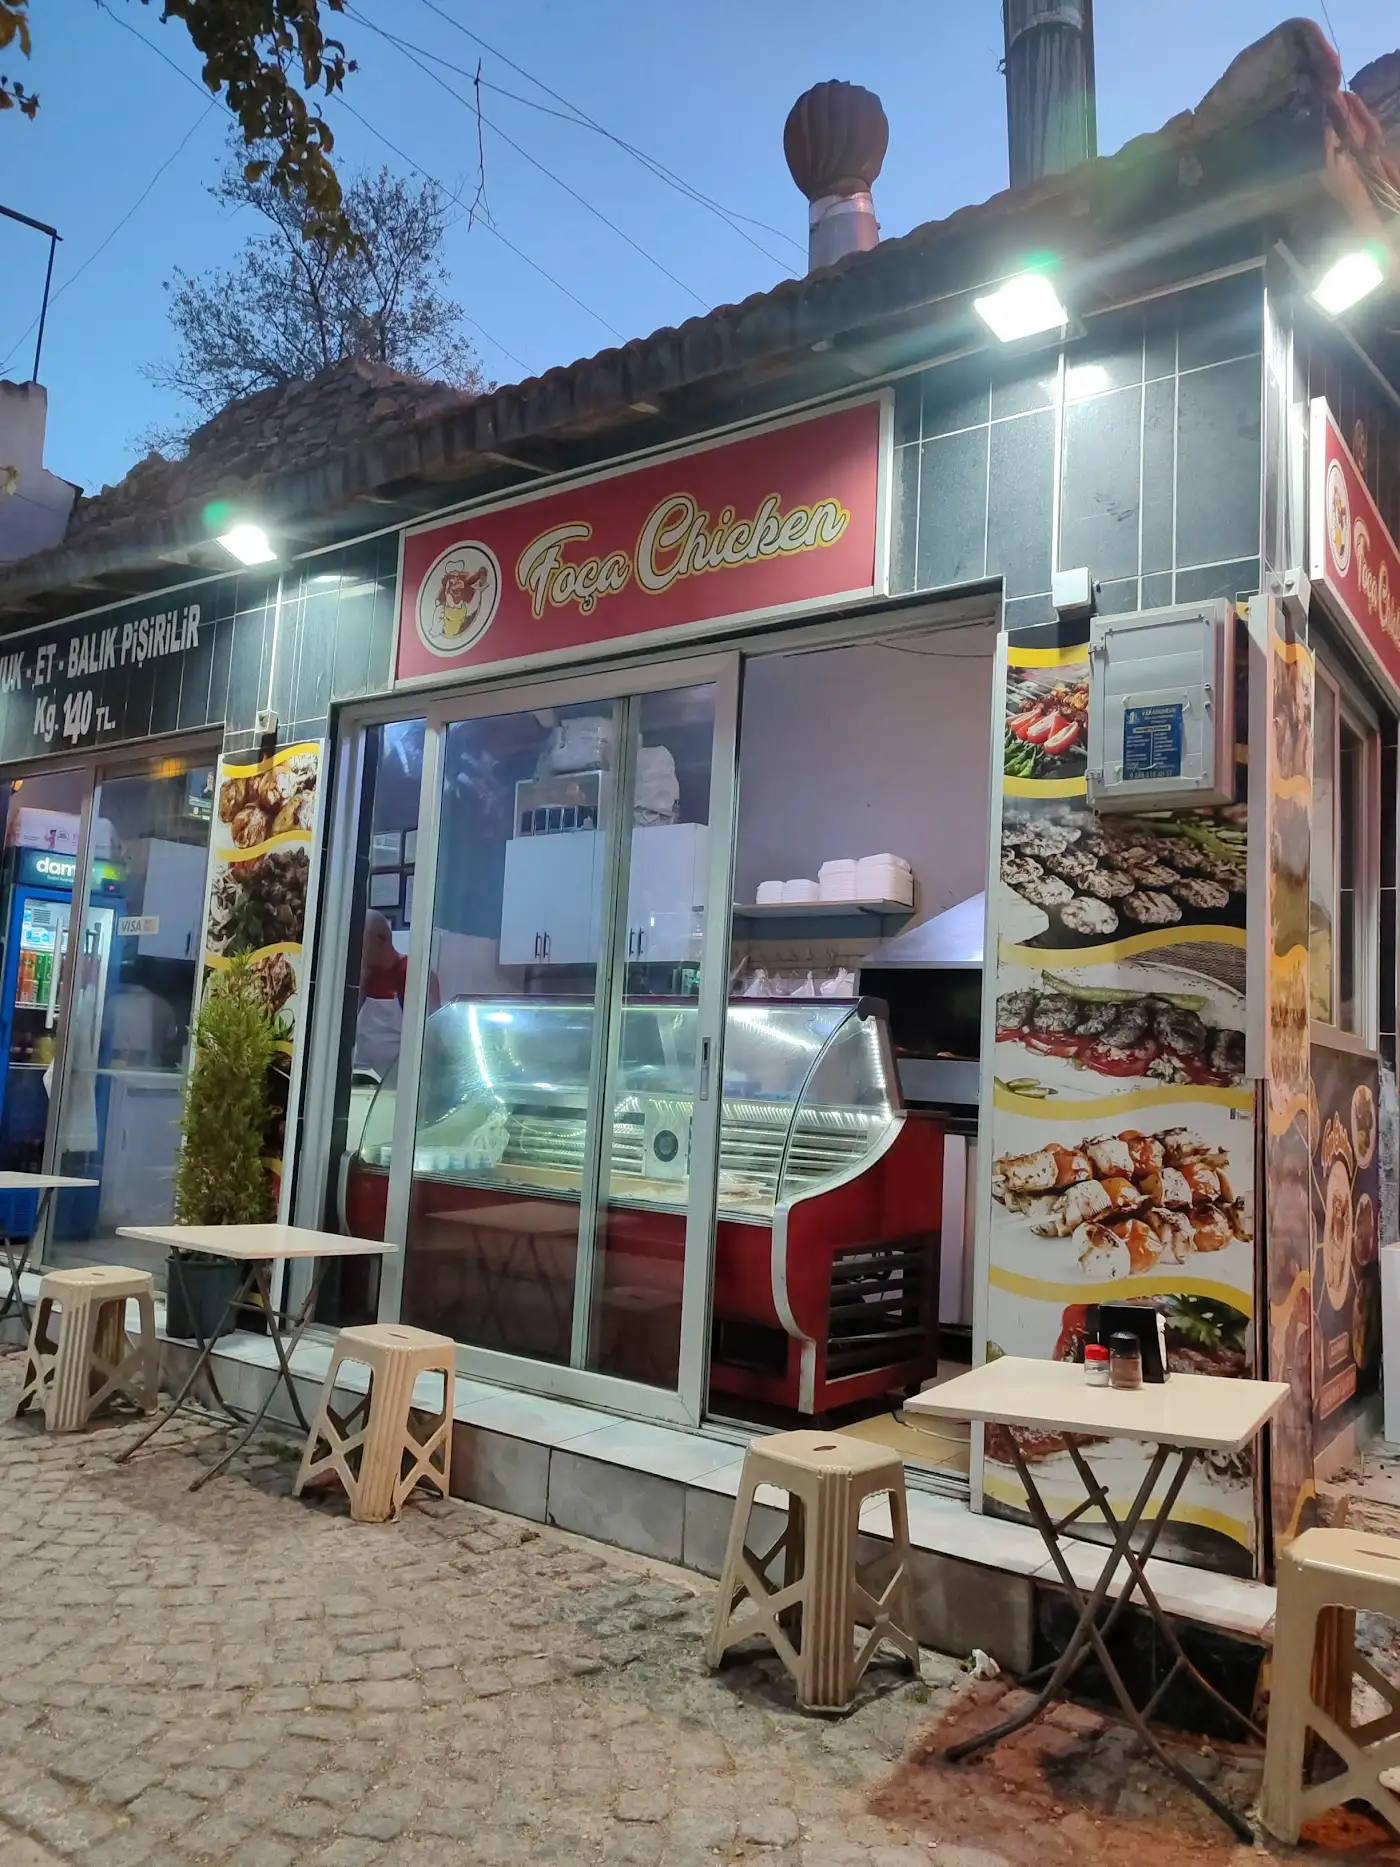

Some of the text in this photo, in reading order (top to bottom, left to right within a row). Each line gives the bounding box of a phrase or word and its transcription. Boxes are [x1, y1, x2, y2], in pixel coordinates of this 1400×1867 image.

[517, 493, 849, 618] Foça Chicken
[35, 643, 57, 686] ET
[67, 626, 119, 679] BALIK
[33, 690, 116, 744] Kg. 140 TL.
[121, 919, 141, 933] VISA
